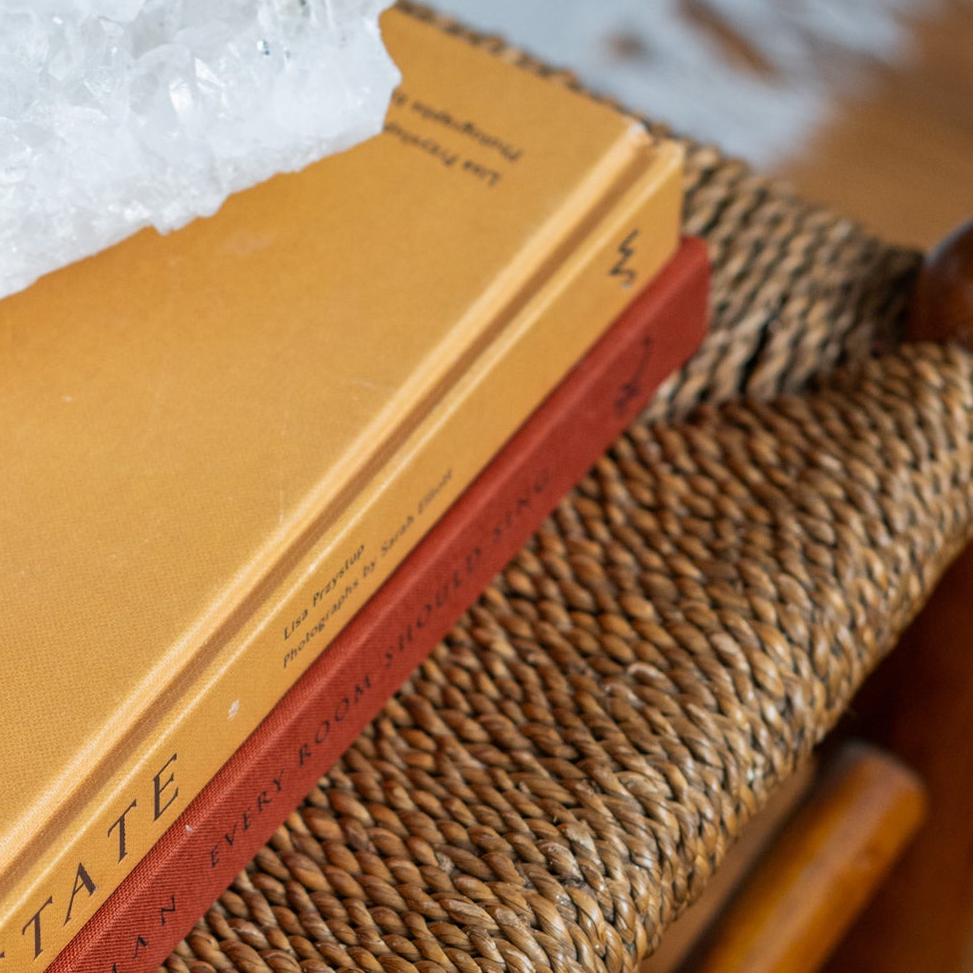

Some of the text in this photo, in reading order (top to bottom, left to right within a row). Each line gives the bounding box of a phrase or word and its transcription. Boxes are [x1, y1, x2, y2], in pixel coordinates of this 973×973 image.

[283, 580, 359, 668] Photographs
[362, 559, 377, 578] by
[380, 515, 414, 557] Sarah
[283, 544, 365, 641] Lisa Przystup
[210, 769, 285, 869] EVERY
[298, 674, 372, 767] ROOM
